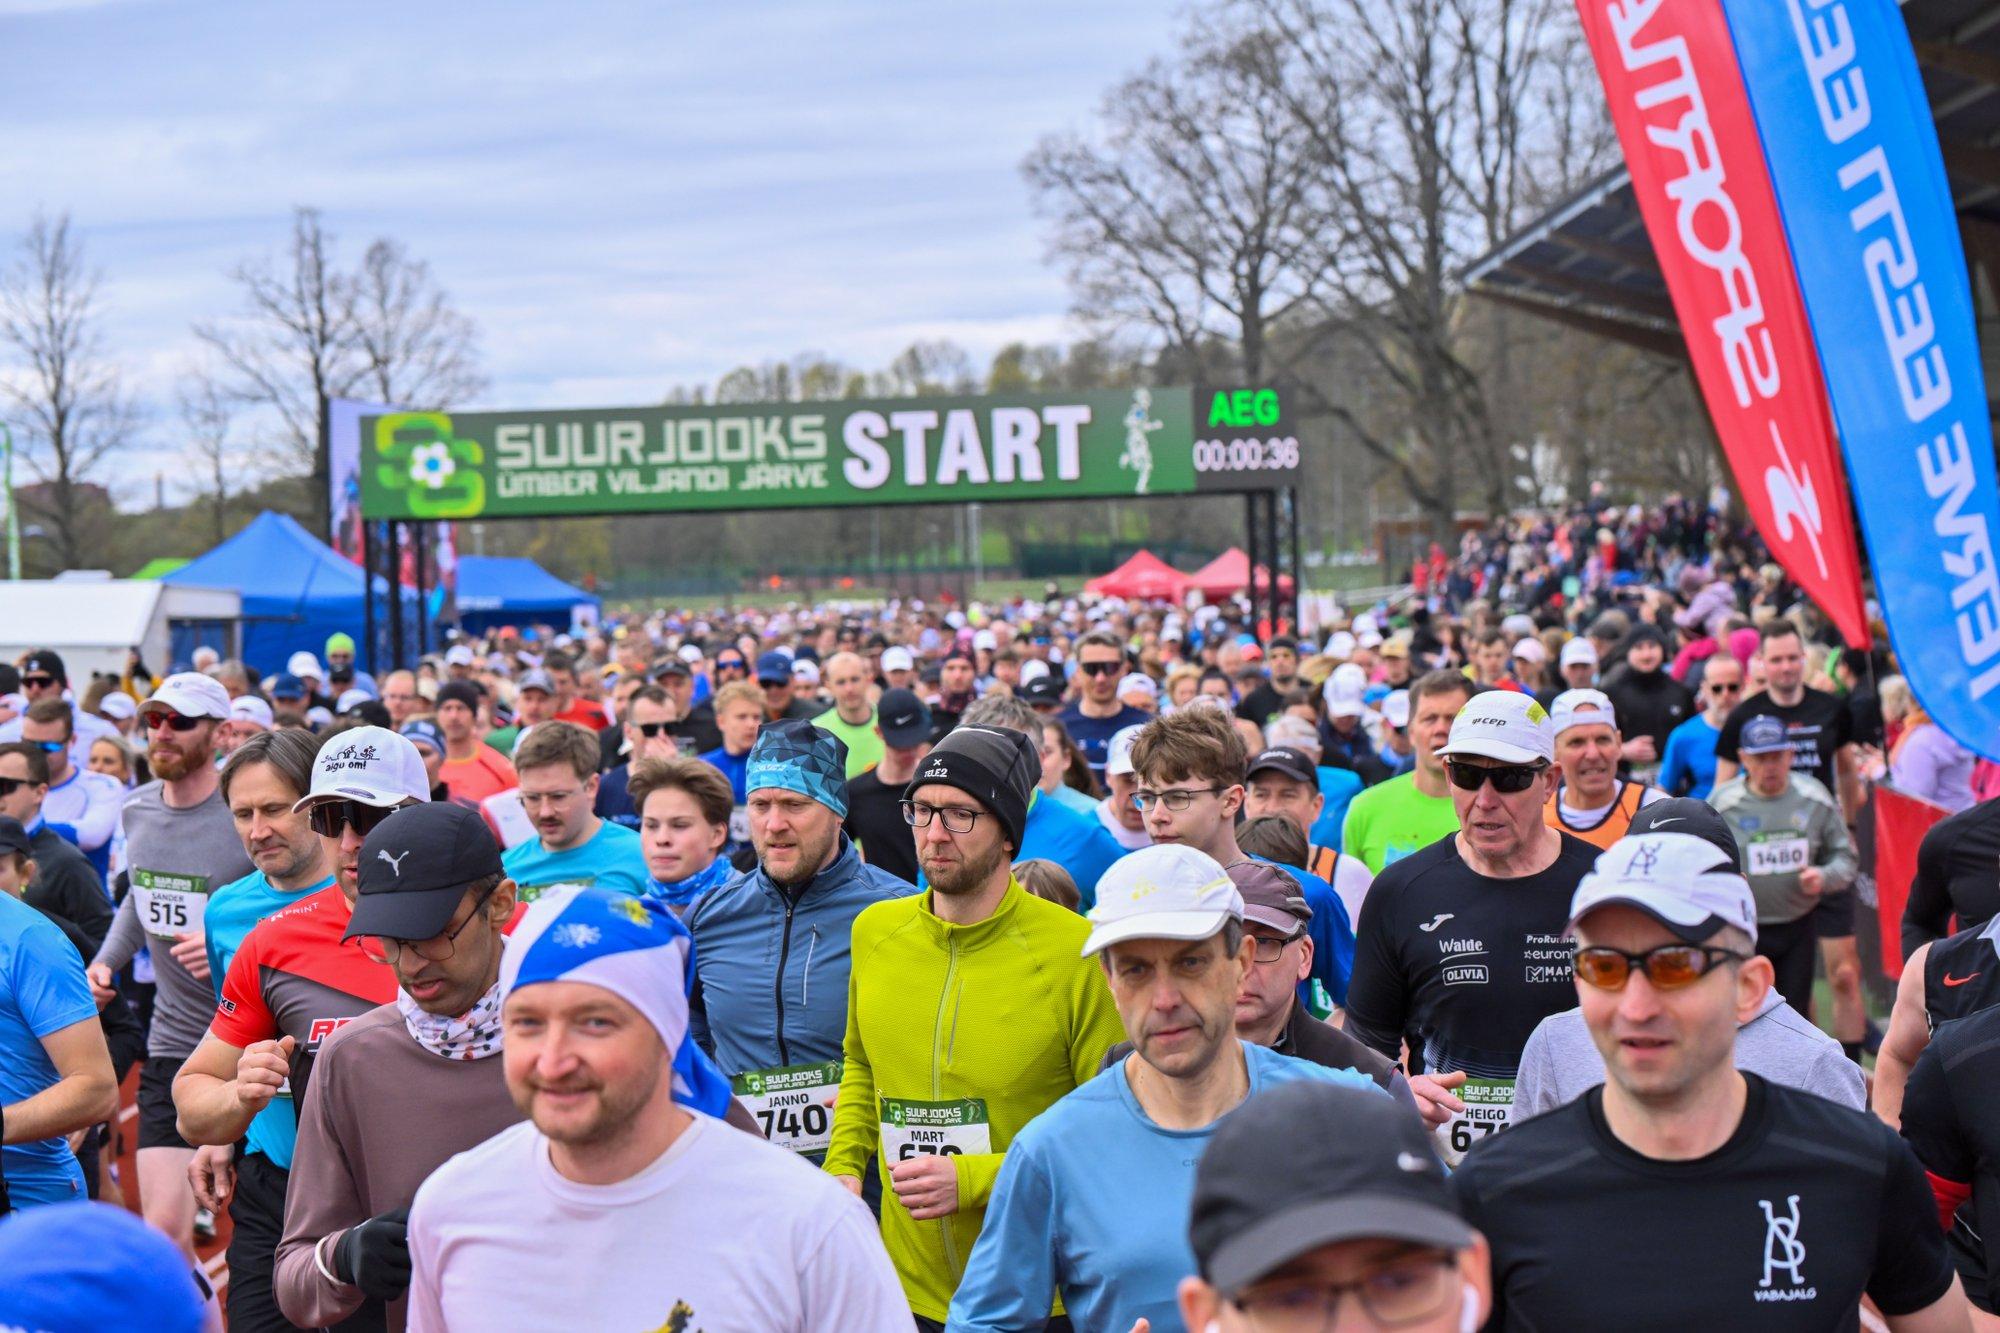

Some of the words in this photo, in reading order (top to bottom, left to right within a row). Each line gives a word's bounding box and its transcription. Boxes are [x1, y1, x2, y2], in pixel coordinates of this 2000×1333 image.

[1207, 389, 1281, 428] AEG
[495, 415, 828, 468] SUURJOOKS
[842, 404, 1092, 489] START
[1192, 436, 1300, 471] 00:00:36
[606, 465, 730, 494] VILJANDI
[738, 461, 829, 491] JÄRVE
[325, 762, 345, 772] aigu
[348, 760, 367, 769] om!
[924, 768, 948, 778] TELE2
[150, 902, 188, 926] 515
[1439, 938, 1483, 953] Walde
[1446, 968, 1484, 981] OLIVIA
[766, 1069, 823, 1085] SUURJOOKS
[769, 1093, 810, 1108] JANNO
[905, 1107, 962, 1118] SUURJOOKS
[1465, 1108, 1507, 1121] HEIGO
[757, 1104, 828, 1140] 740
[911, 1130, 945, 1143] MART
[1450, 1120, 1511, 1153] 67
